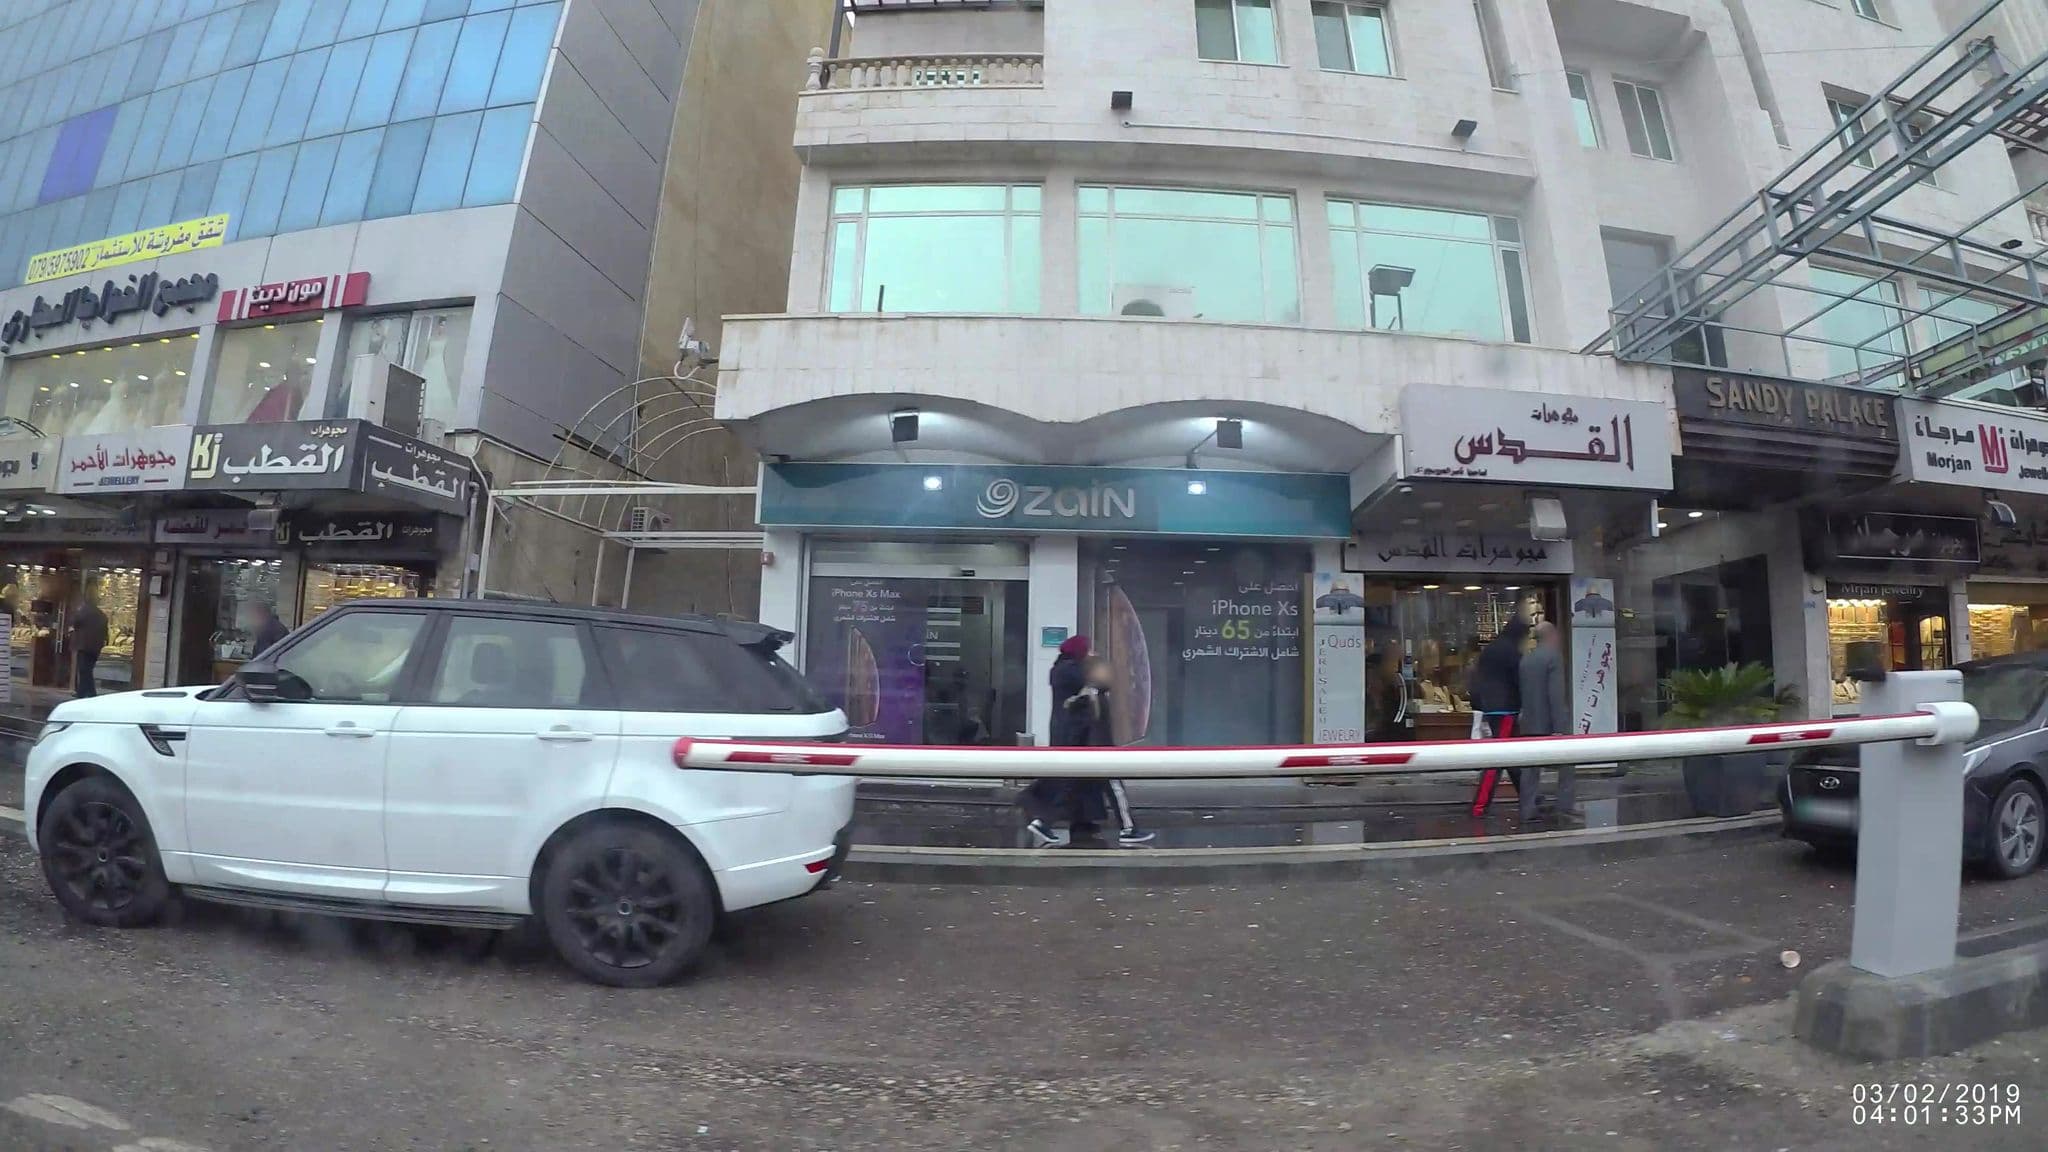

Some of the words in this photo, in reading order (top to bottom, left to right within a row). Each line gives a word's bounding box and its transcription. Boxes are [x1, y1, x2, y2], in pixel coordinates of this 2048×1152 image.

[249, 282, 288, 311] لايت
[287, 282, 323, 303] مون
[1705, 377, 1794, 417] SANDY
[1804, 389, 1889, 428] PALACE
[1454, 413, 1635, 472] القدس
[70, 443, 109, 473] الأحمر
[111, 446, 177, 470] مجوهرات
[222, 441, 346, 484] القطب
[1926, 451, 1972, 473] Morjan
[371, 459, 467, 501] القطب
[298, 520, 394, 546] القطب
[1377, 535, 1449, 563] القدس
[1455, 535, 1549, 566] مجوهرات
[831, 588, 864, 598] iPhone
[880, 589, 901, 599] Max
[1238, 581, 1262, 594] على
[1212, 599, 1272, 616] iPhone
[1277, 600, 1299, 616] Xs
[1193, 625, 1218, 638] دينار
[1221, 619, 1251, 640] 65
[1254, 628, 1270, 639] من
[1182, 644, 1222, 661] الشهري
[1327, 634, 1362, 650] Quds
[1224, 646, 1269, 660] الاشتراك
[1270, 646, 1300, 660] شامل
